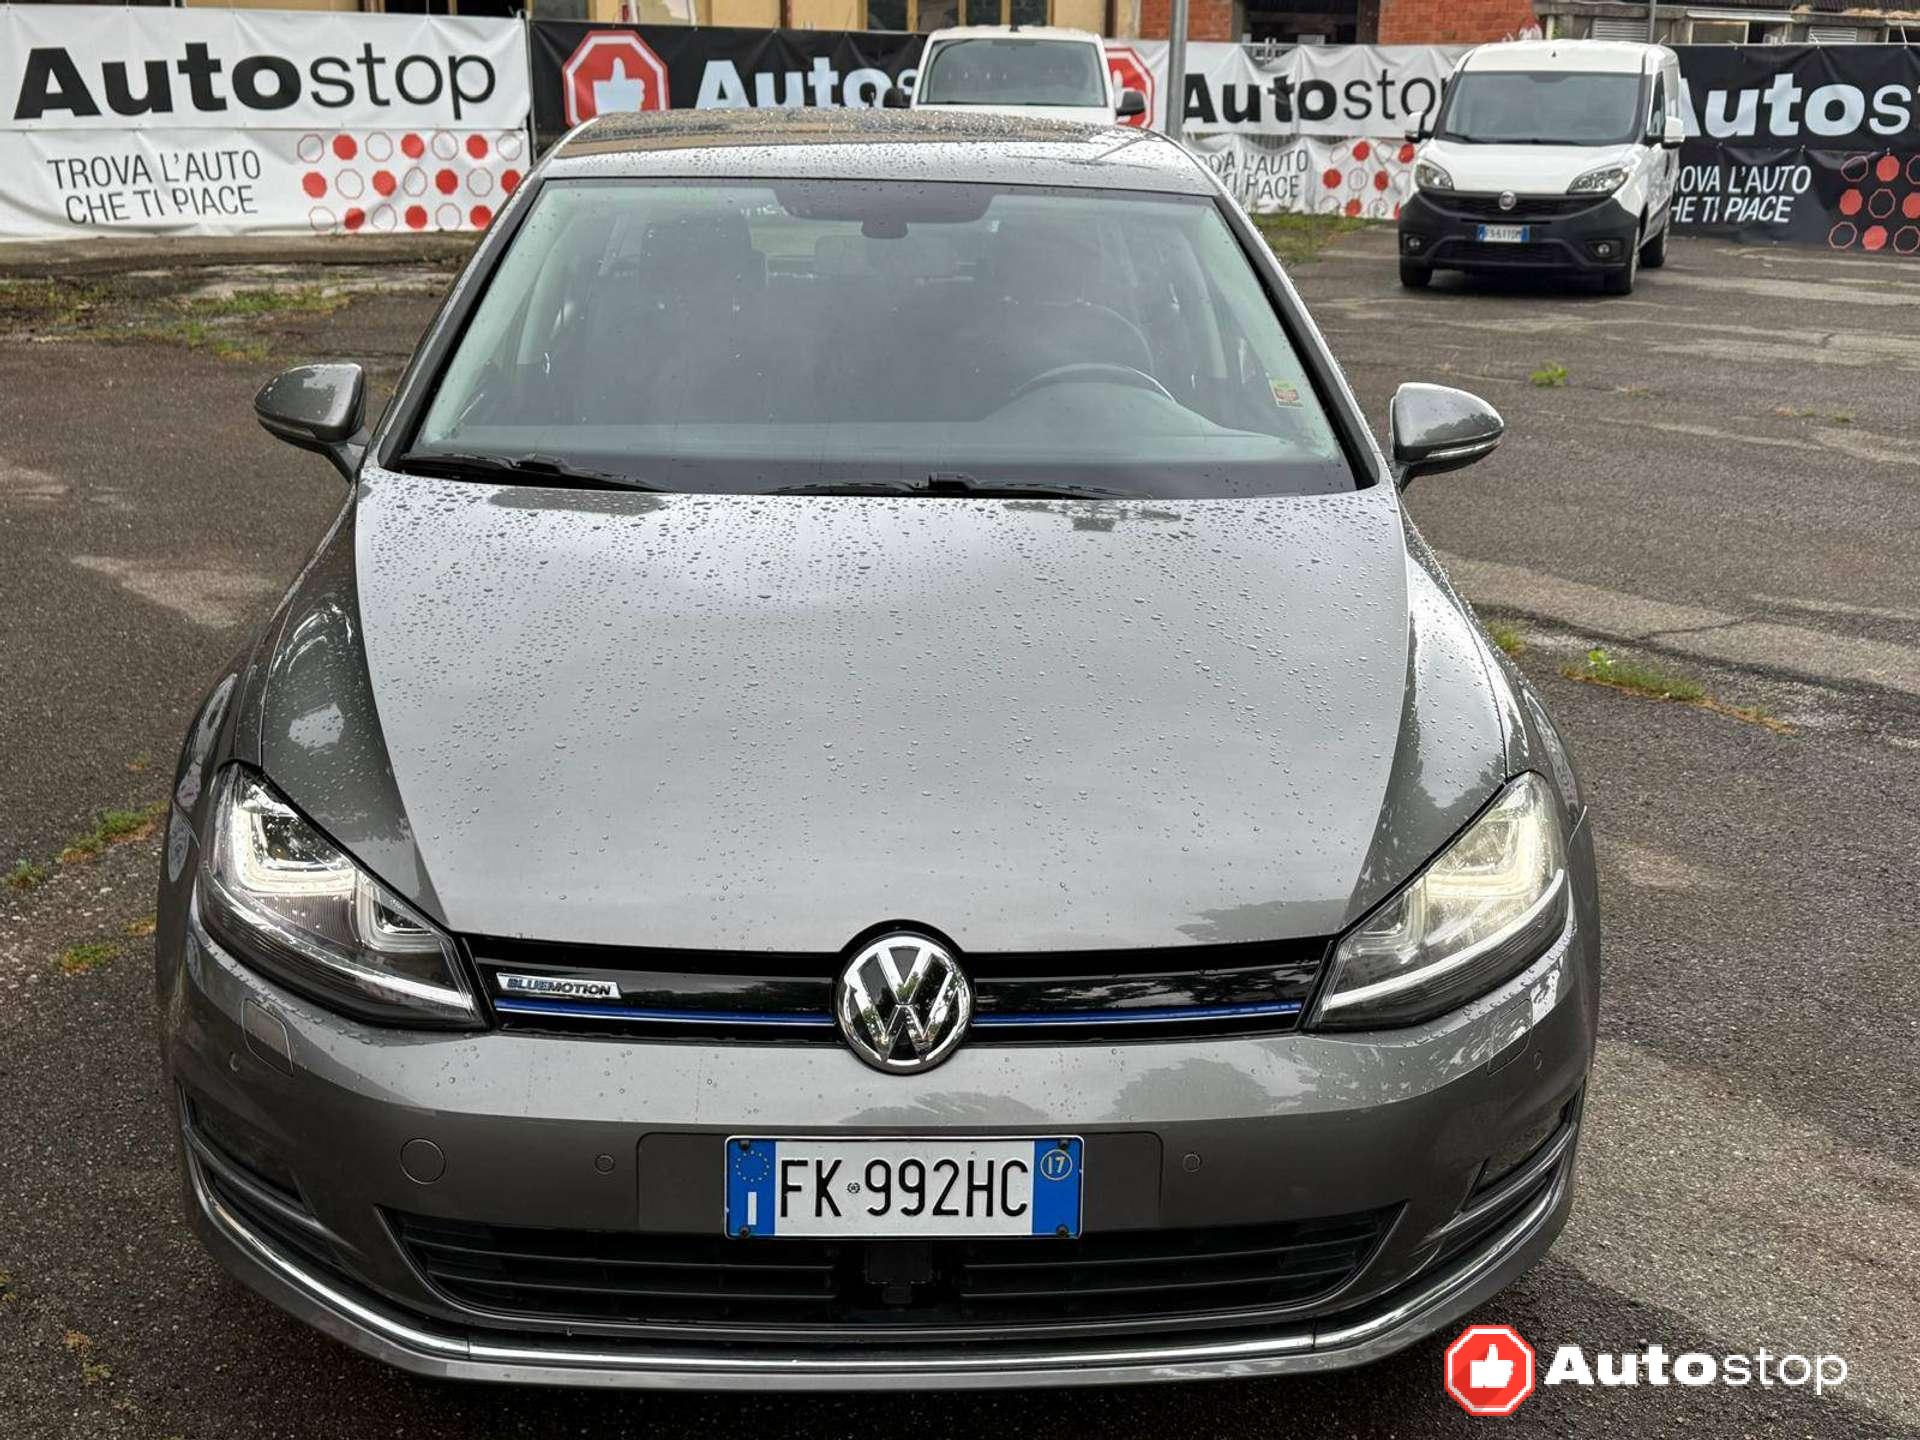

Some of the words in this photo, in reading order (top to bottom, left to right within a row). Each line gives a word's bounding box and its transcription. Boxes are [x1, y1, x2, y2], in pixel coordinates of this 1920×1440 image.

[13, 42, 496, 120] Autostop
[1184, 68, 1447, 124] Autosto
[47, 155, 153, 189] TROVA
[160, 150, 261, 182] L'AUTO
[1675, 165, 1720, 192] OVA
[1727, 165, 1812, 194] L'AUTO
[66, 192, 130, 224] CHE
[133, 190, 165, 217] TI
[172, 185, 258, 216] PIACE
[1702, 196, 1720, 222] TI
[1724, 195, 1794, 223] PIACE
[507, 978, 611, 995] BLUEMOTION
[1047, 1156, 1066, 1174] 17
